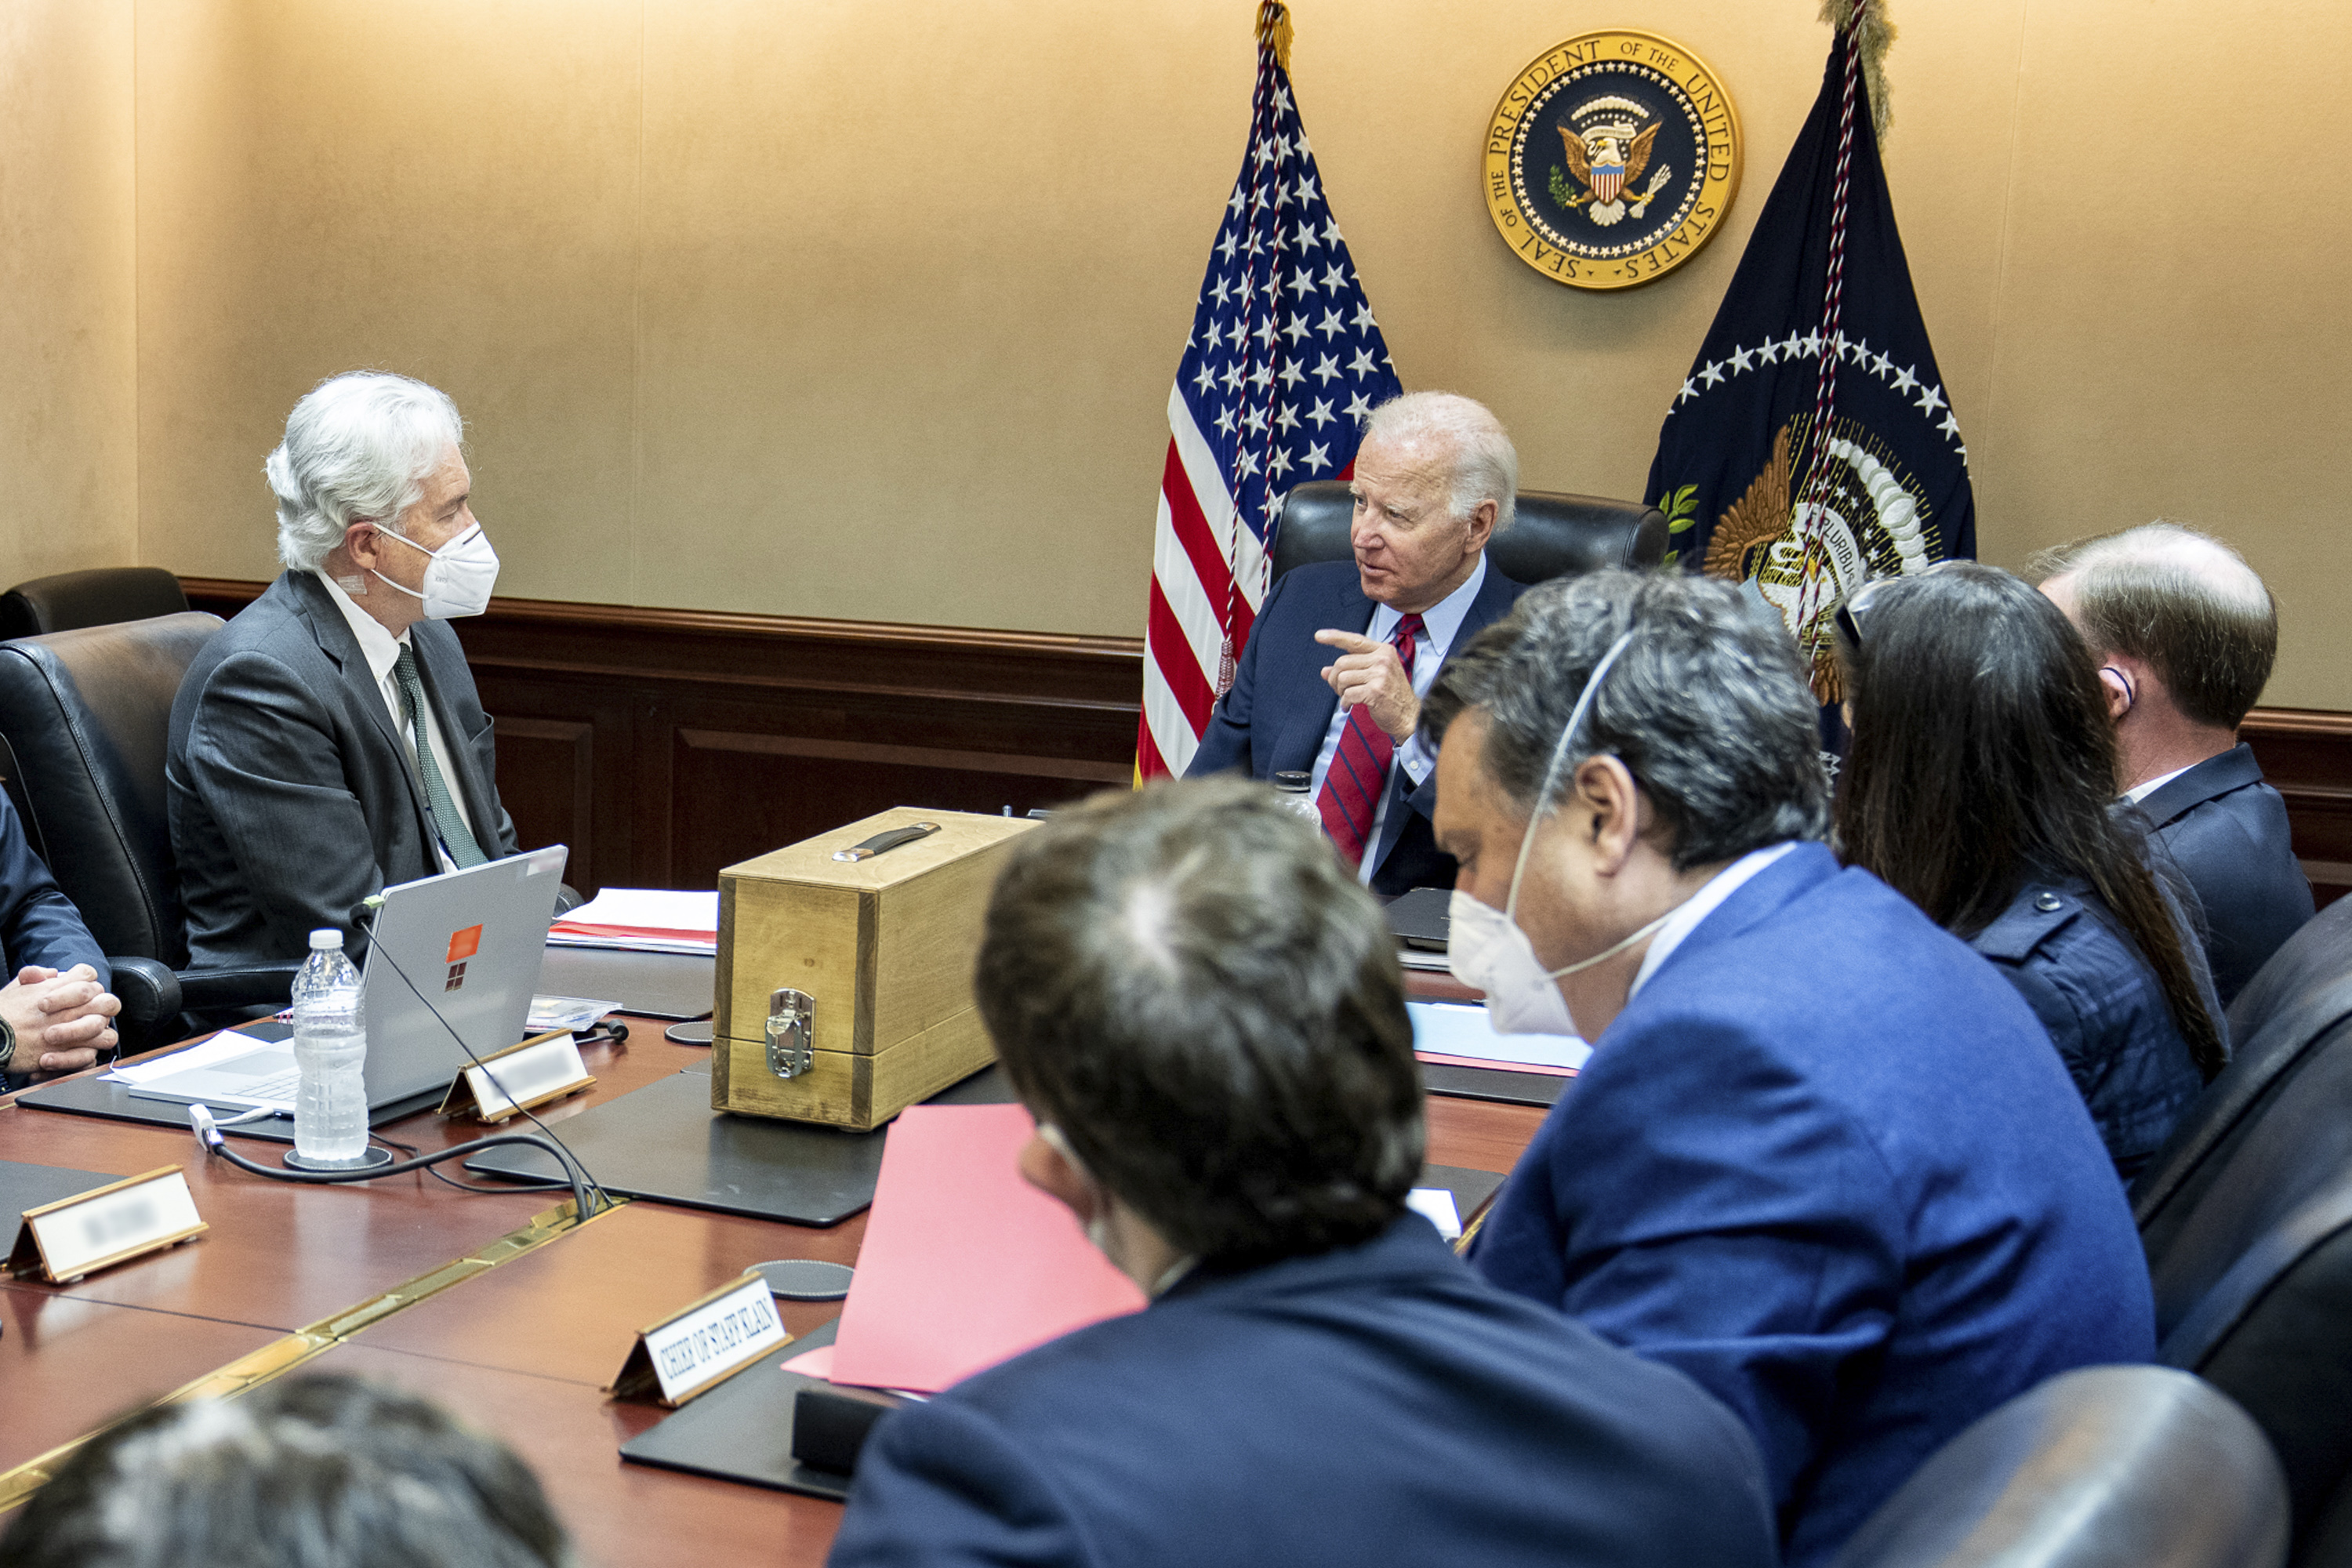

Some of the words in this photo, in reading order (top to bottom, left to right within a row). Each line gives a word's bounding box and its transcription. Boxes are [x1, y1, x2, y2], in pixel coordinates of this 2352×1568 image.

[1620, 41, 1643, 56] OF
[1650, 47, 1679, 72] THE
[1490, 39, 1600, 155] PRESIDENT
[1686, 72, 1731, 182] UNITED
[1490, 169, 1507, 201] THE
[1500, 208, 1518, 227] OF
[1624, 201, 1715, 279] STATES
[1520, 230, 1581, 278] SEAL
[659, 1336, 696, 1380] CHIEF
[692, 1329, 711, 1363] OF
[708, 1313, 742, 1356] STAFF
[738, 1297, 775, 1339] KLAIN
